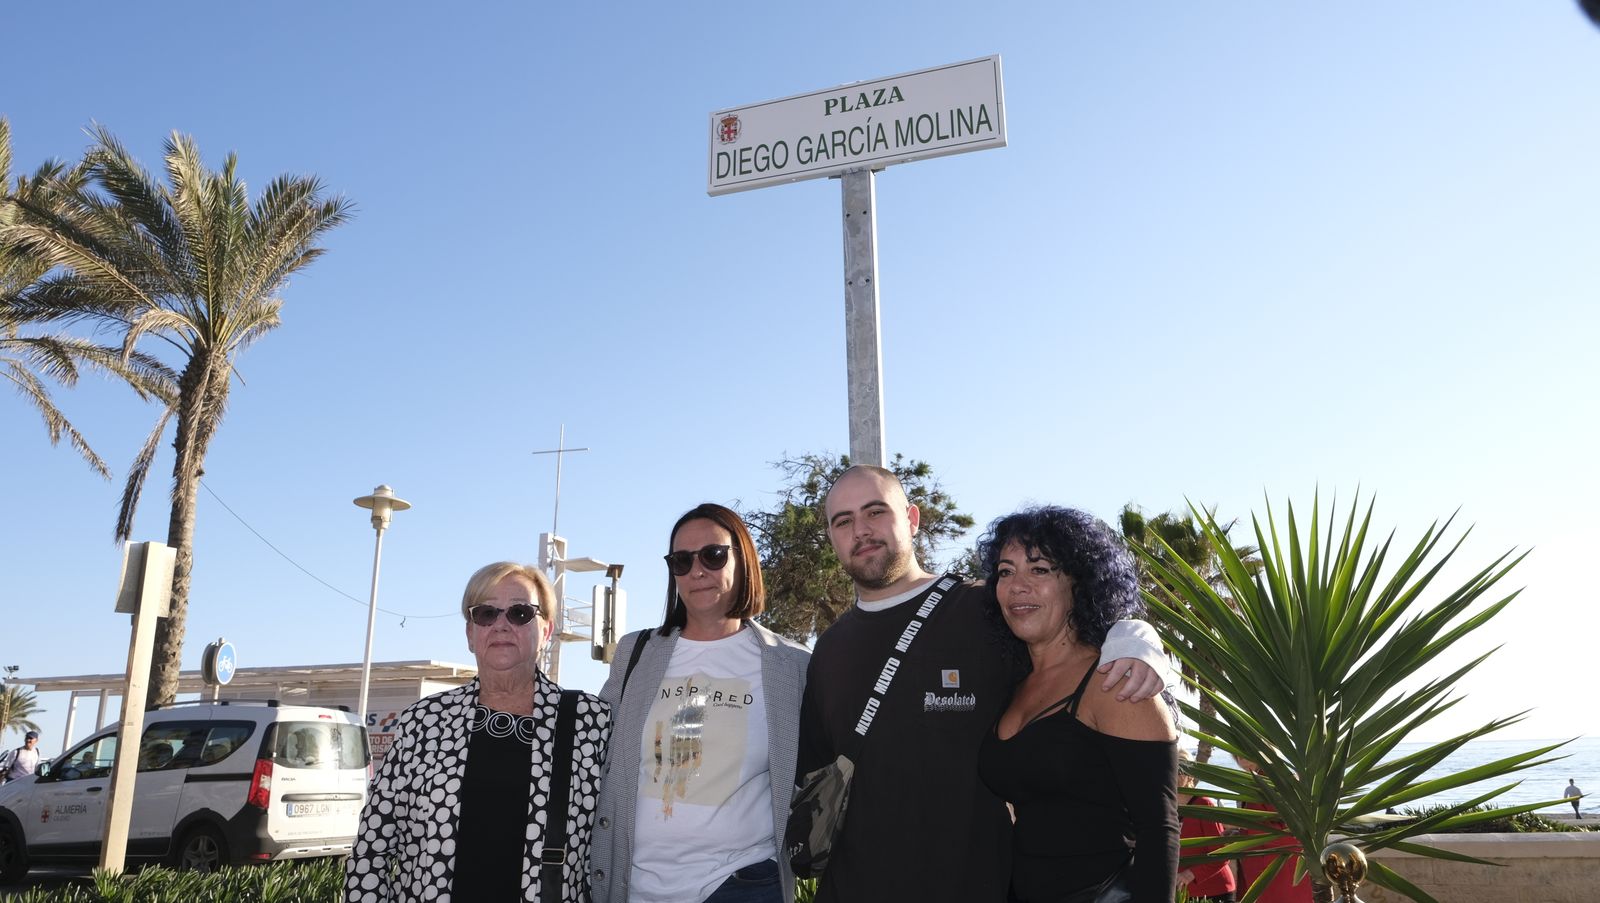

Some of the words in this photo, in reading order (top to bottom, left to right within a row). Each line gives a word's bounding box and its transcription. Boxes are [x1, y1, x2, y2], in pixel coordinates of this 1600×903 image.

[824, 86, 905, 116] PLAZA
[716, 140, 789, 179] DIEGO
[796, 117, 889, 165] GARCÍA
[895, 103, 993, 148] MOLINA
[924, 691, 976, 706] Desolated
[55, 802, 87, 815] ALMERÍA
[294, 804, 314, 814] 0967
